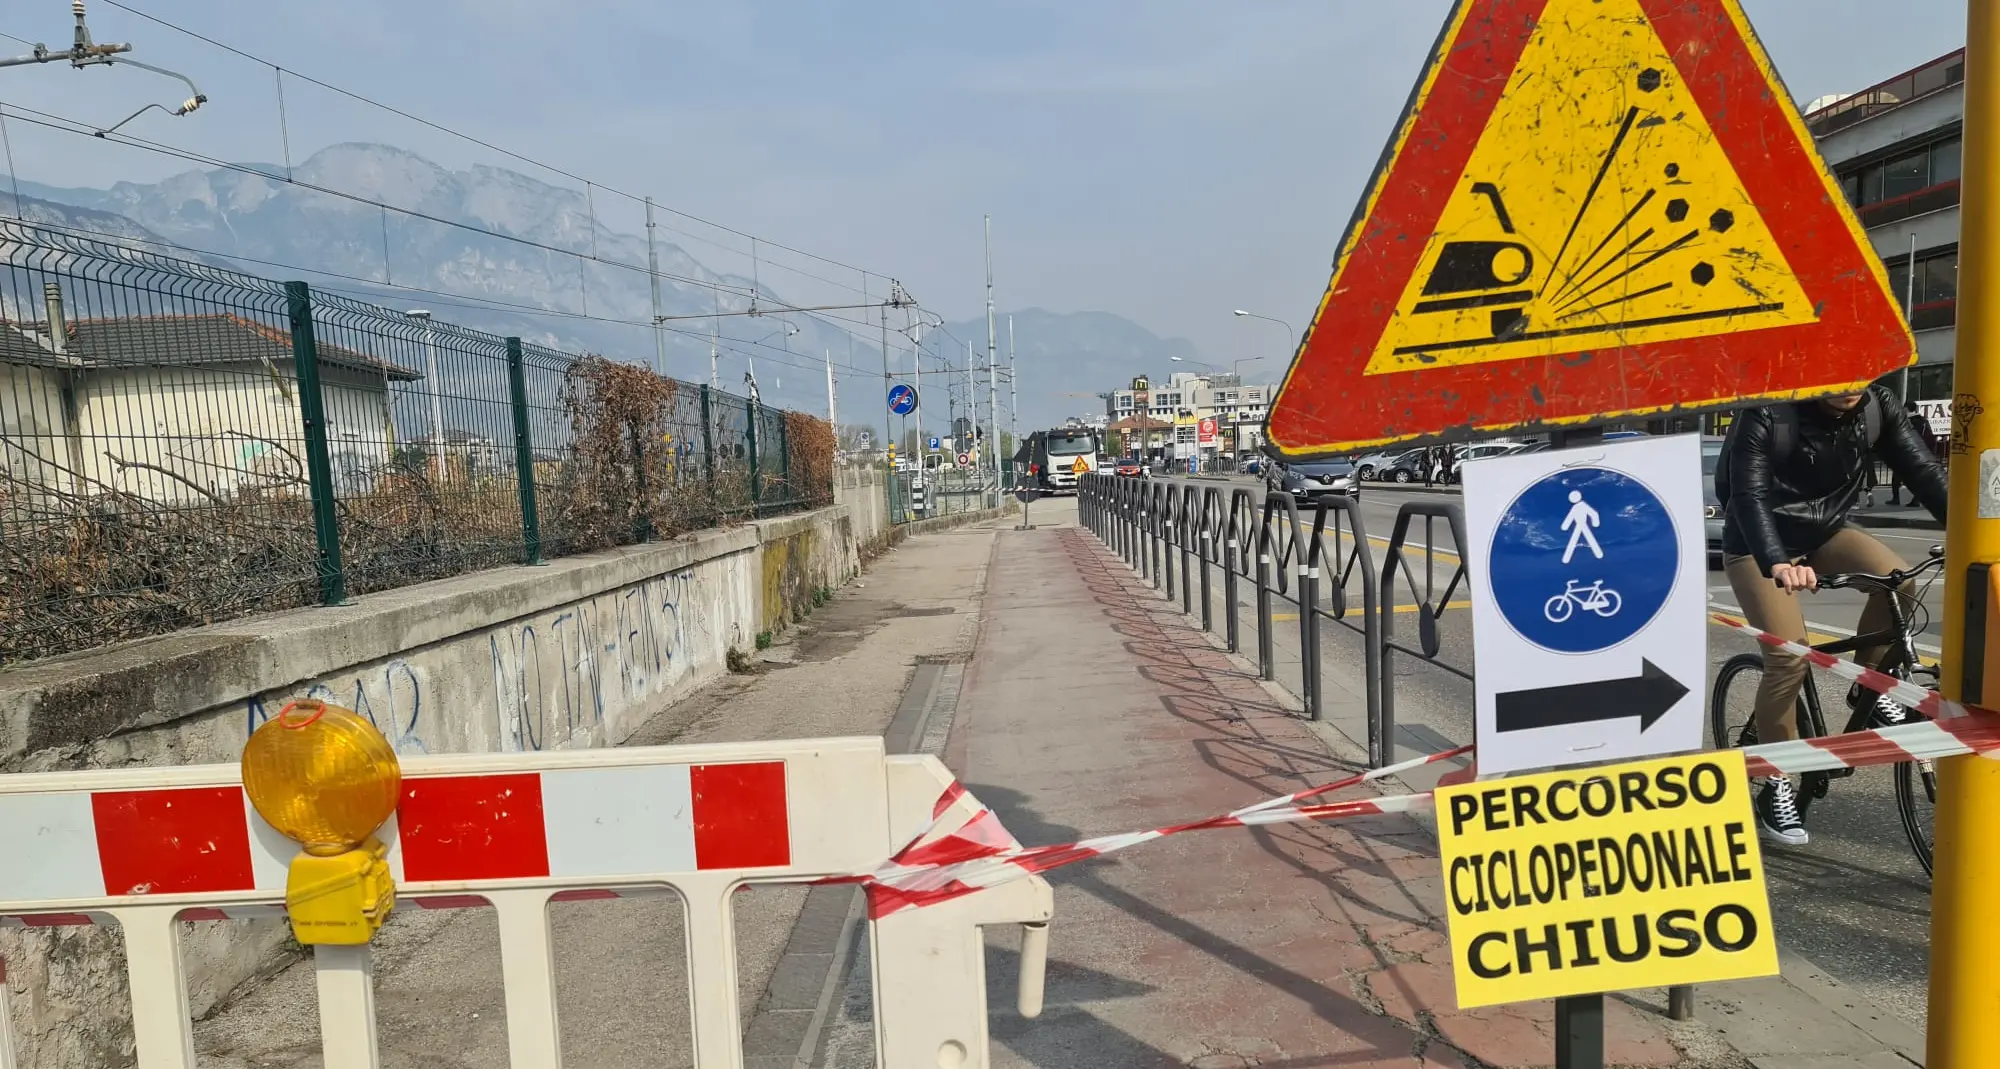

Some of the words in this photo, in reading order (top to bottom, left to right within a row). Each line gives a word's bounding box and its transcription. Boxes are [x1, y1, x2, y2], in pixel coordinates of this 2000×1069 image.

[1450, 762, 1727, 836] PERCORSO
[1450, 822, 1752, 916] CICLOPEDONALE
[1467, 903, 1758, 979] CHIUSO
